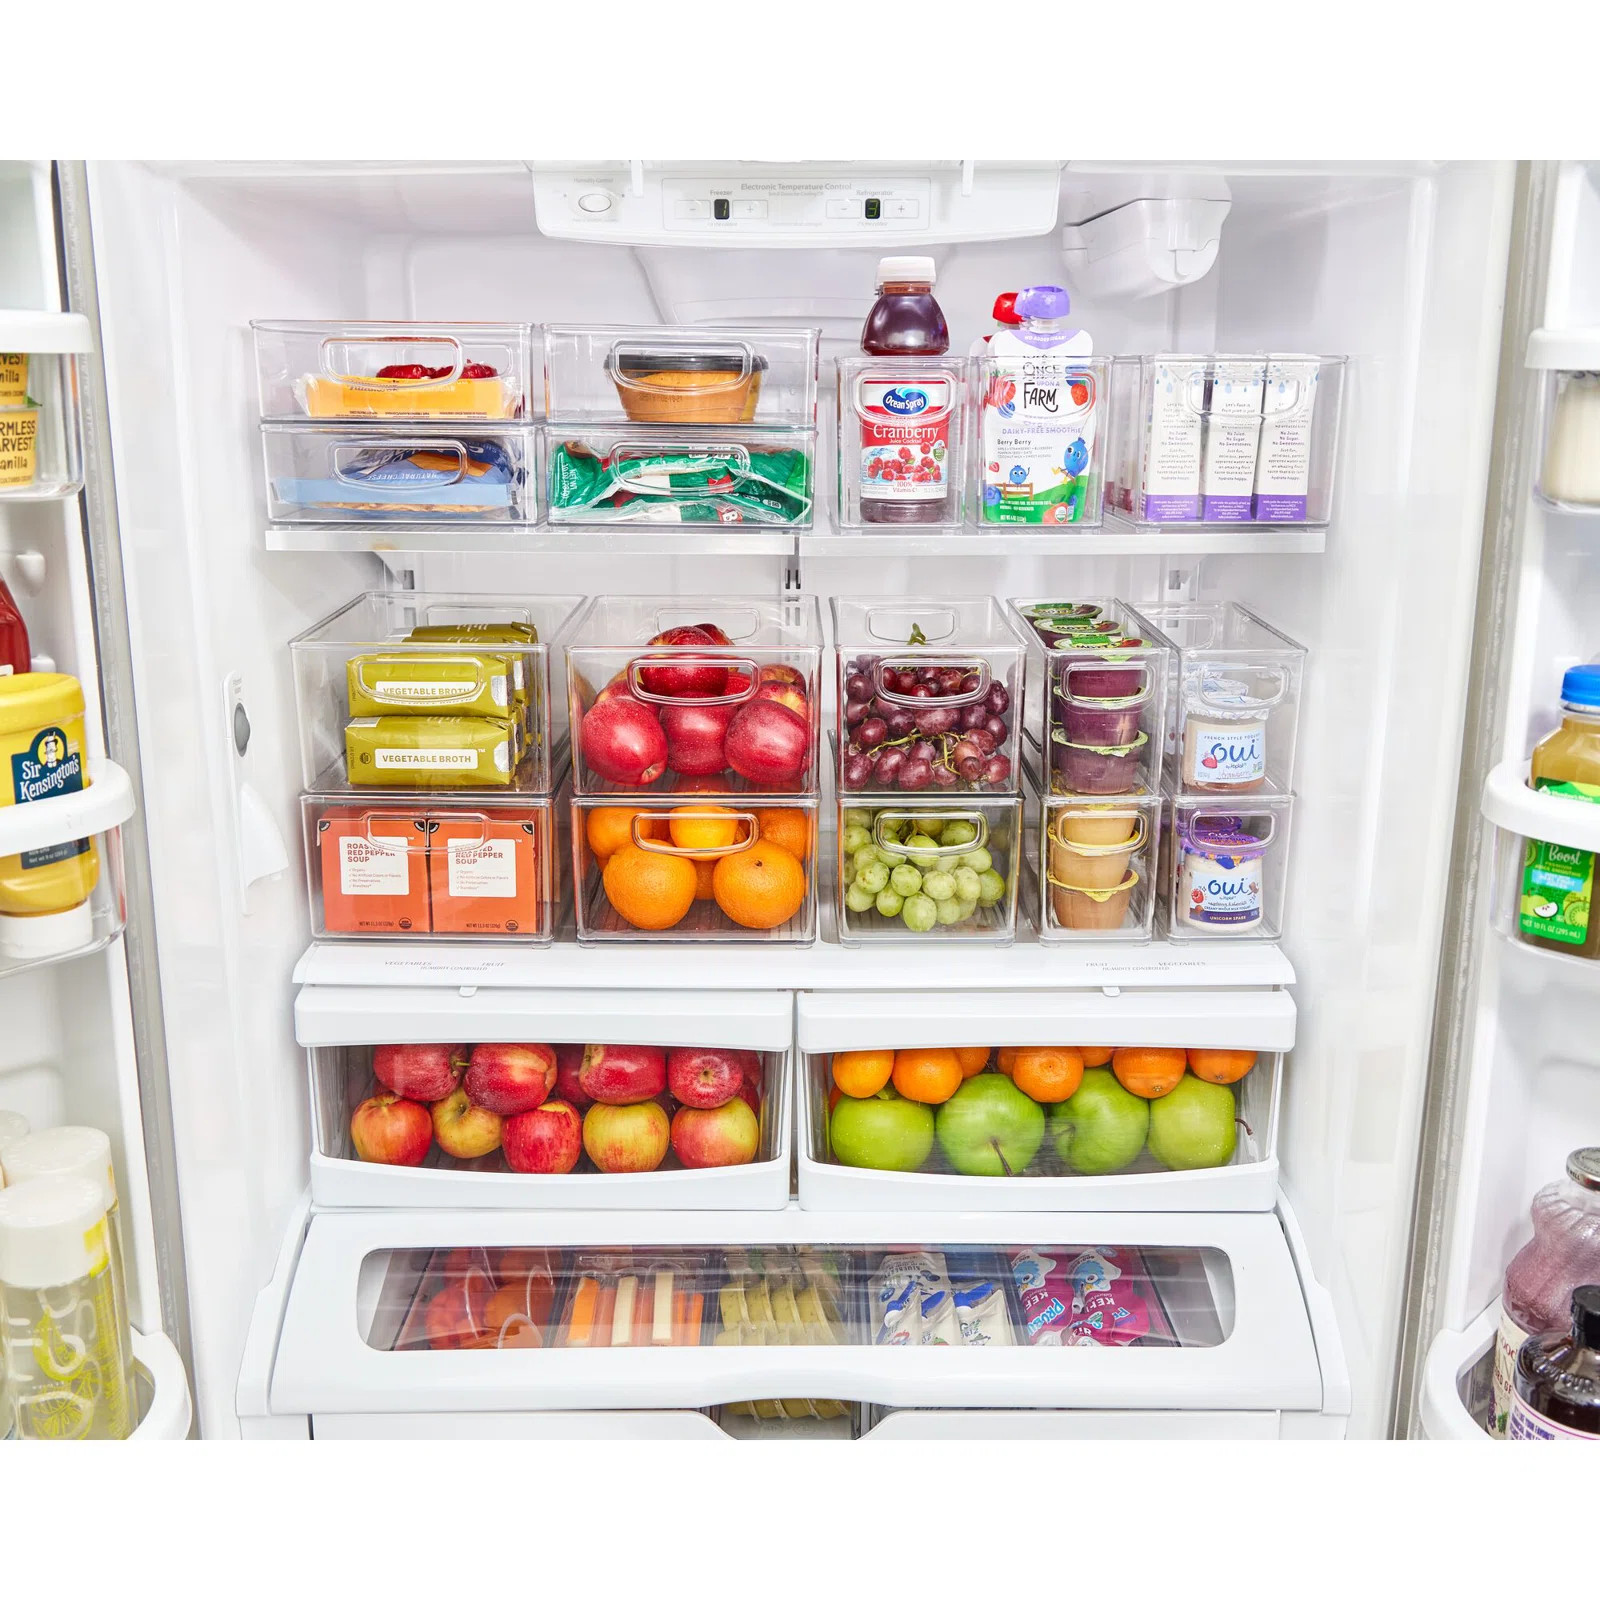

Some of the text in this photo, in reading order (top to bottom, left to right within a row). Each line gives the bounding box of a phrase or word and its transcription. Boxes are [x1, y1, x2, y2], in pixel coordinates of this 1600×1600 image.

[778, 184, 824, 192] Temperature
[868, 201, 879, 216] 3
[885, 395, 924, 410] Ocean Spray
[1024, 382, 1058, 412] FARM
[874, 424, 939, 444] Cranberry
[383, 687, 470, 696] VEGETABLE BROTH
[20, 754, 79, 801] Kensington's
[22, 760, 41, 780] Sir
[1548, 844, 1582, 864] Boost
[1523, 919, 1532, 928] NET
[1541, 923, 1546, 931] FL
[1548, 925, 1555, 933] OZ
